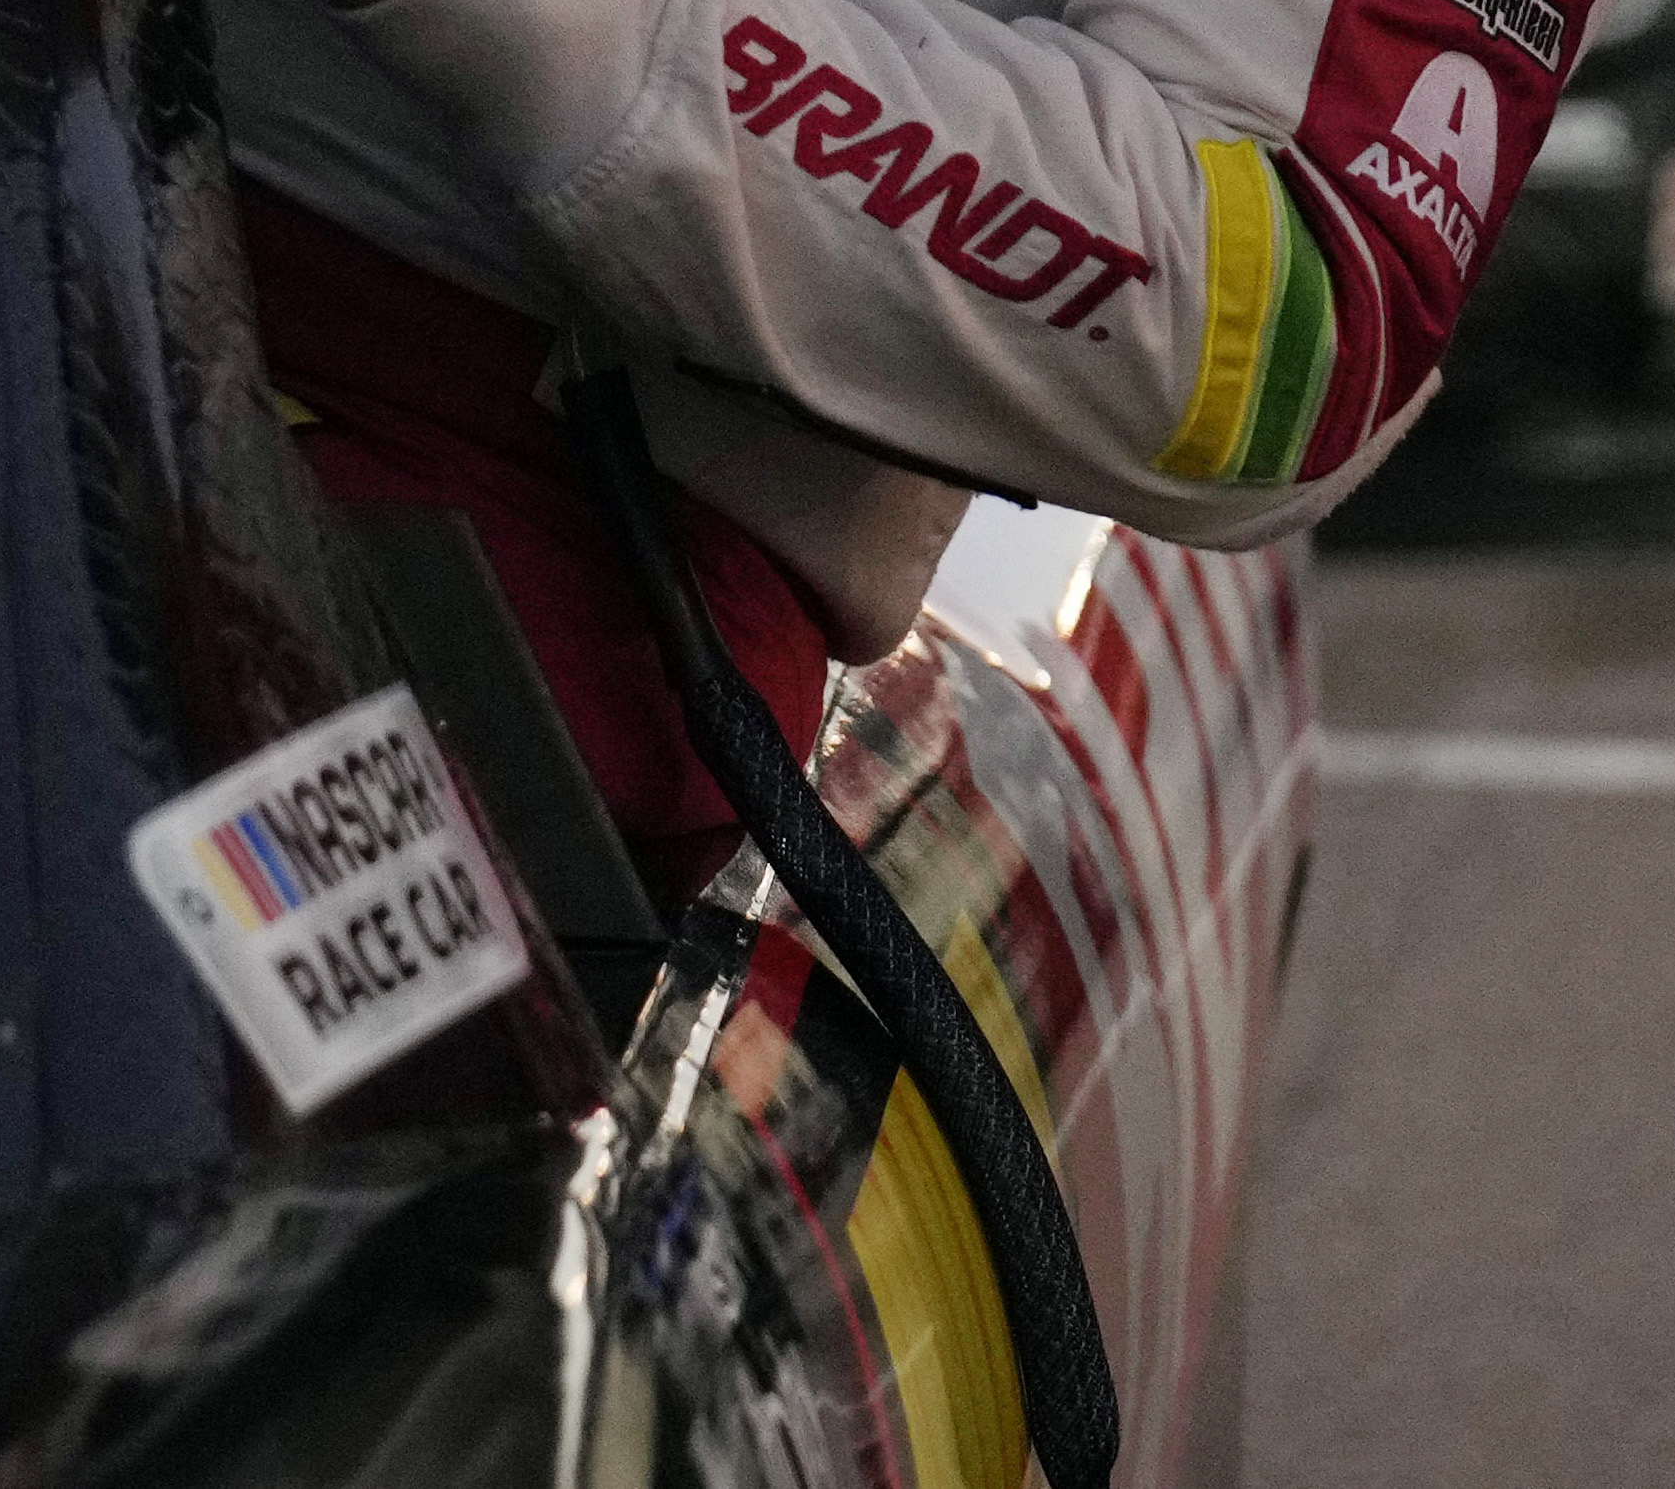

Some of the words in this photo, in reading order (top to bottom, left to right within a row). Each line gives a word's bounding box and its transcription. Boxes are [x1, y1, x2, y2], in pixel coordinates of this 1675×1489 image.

[1346, 142, 1479, 282] AXALTA
[254, 729, 448, 901] NASCAR
[276, 900, 424, 1036] RACE
[405, 859, 495, 962] CAR
